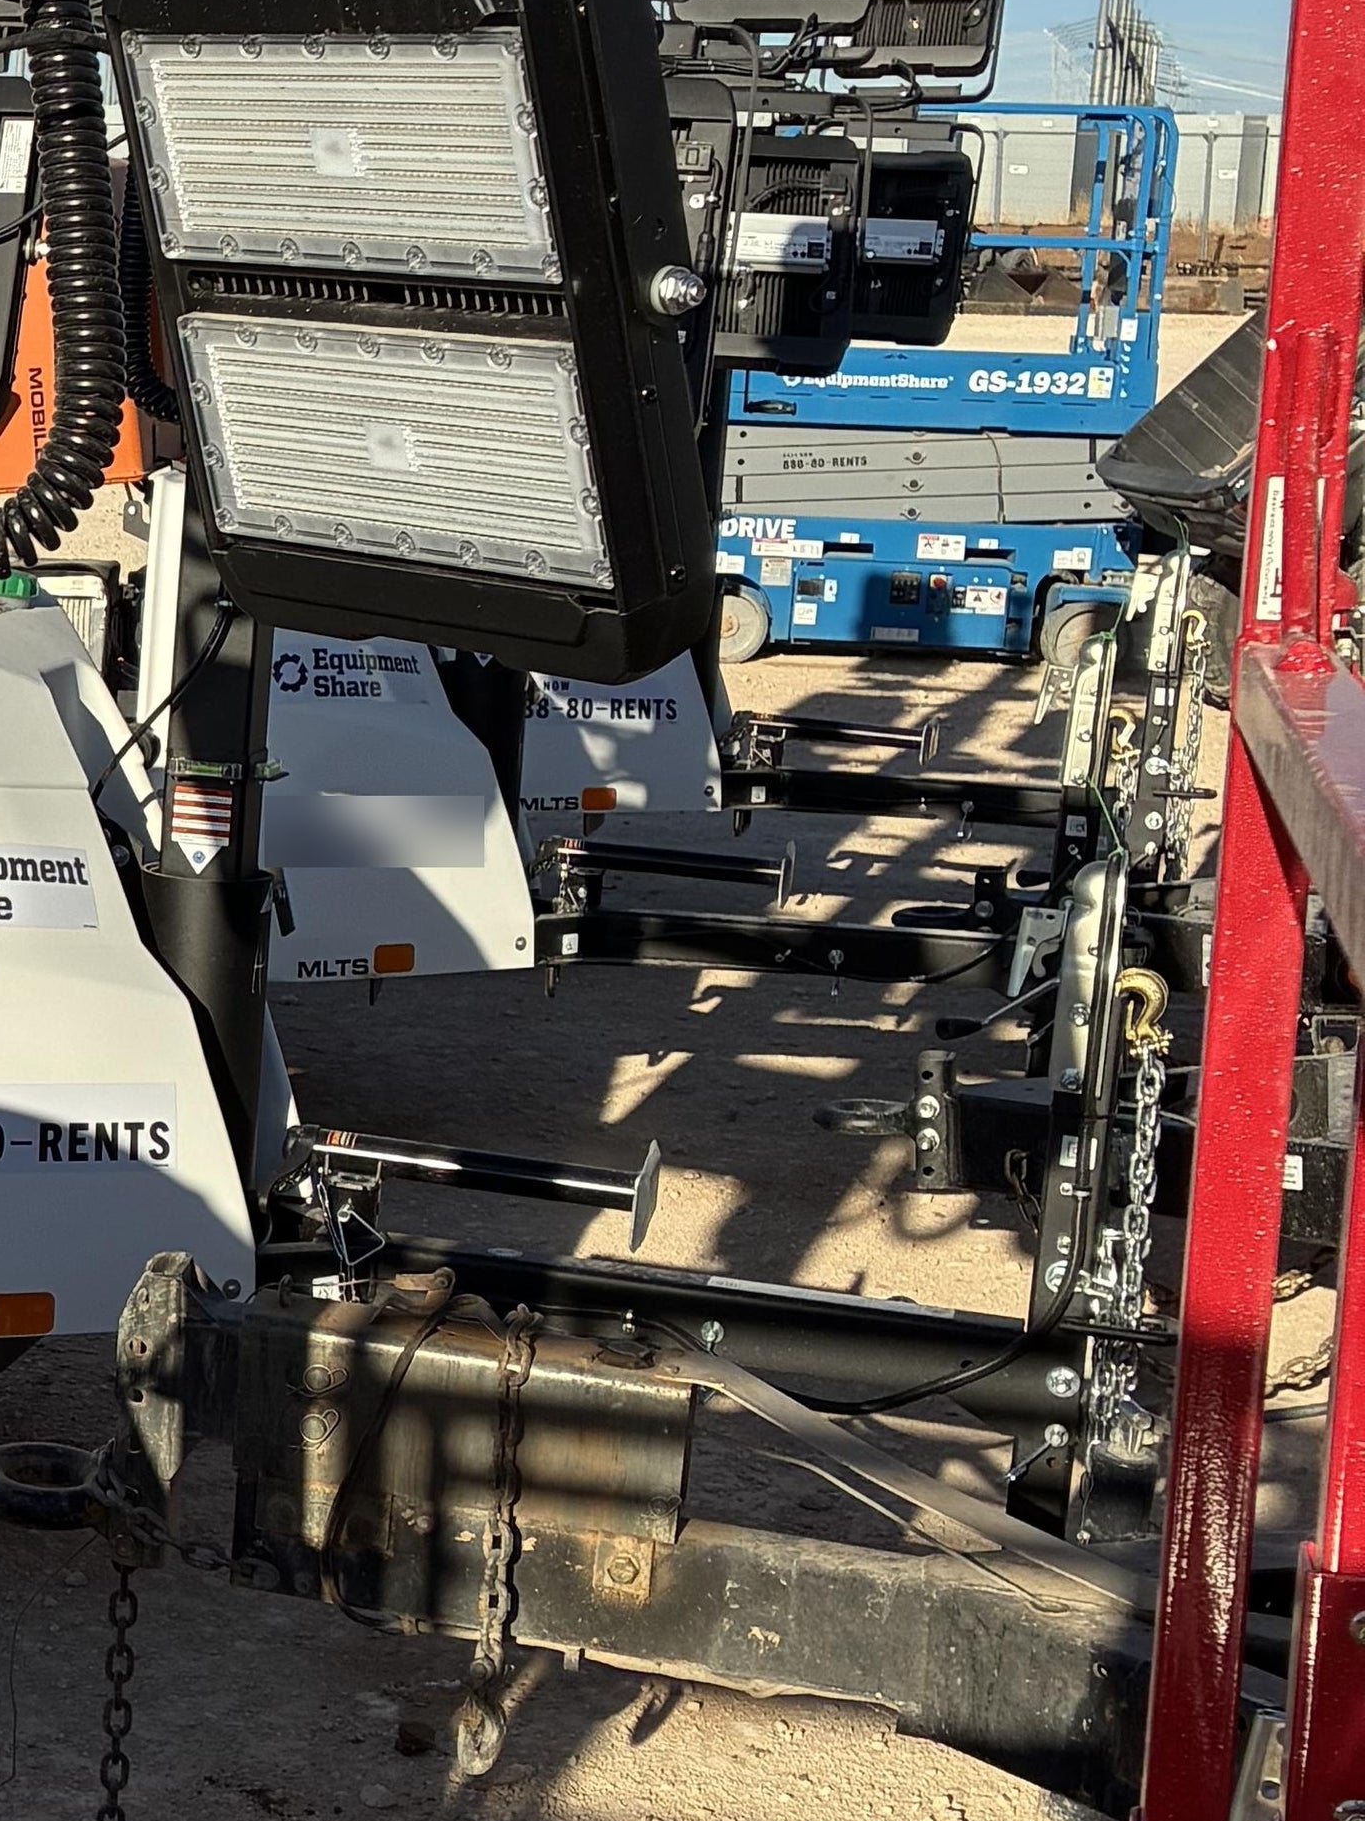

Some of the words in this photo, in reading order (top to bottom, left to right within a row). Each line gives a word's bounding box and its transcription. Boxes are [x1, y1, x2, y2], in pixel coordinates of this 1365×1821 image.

[969, 369, 1086, 396] GS-1932
[312, 648, 421, 674] Equipment
[314, 680, 382, 698] Share
[519, 796, 579, 812] MLTS
[297, 958, 370, 978] MLTS
